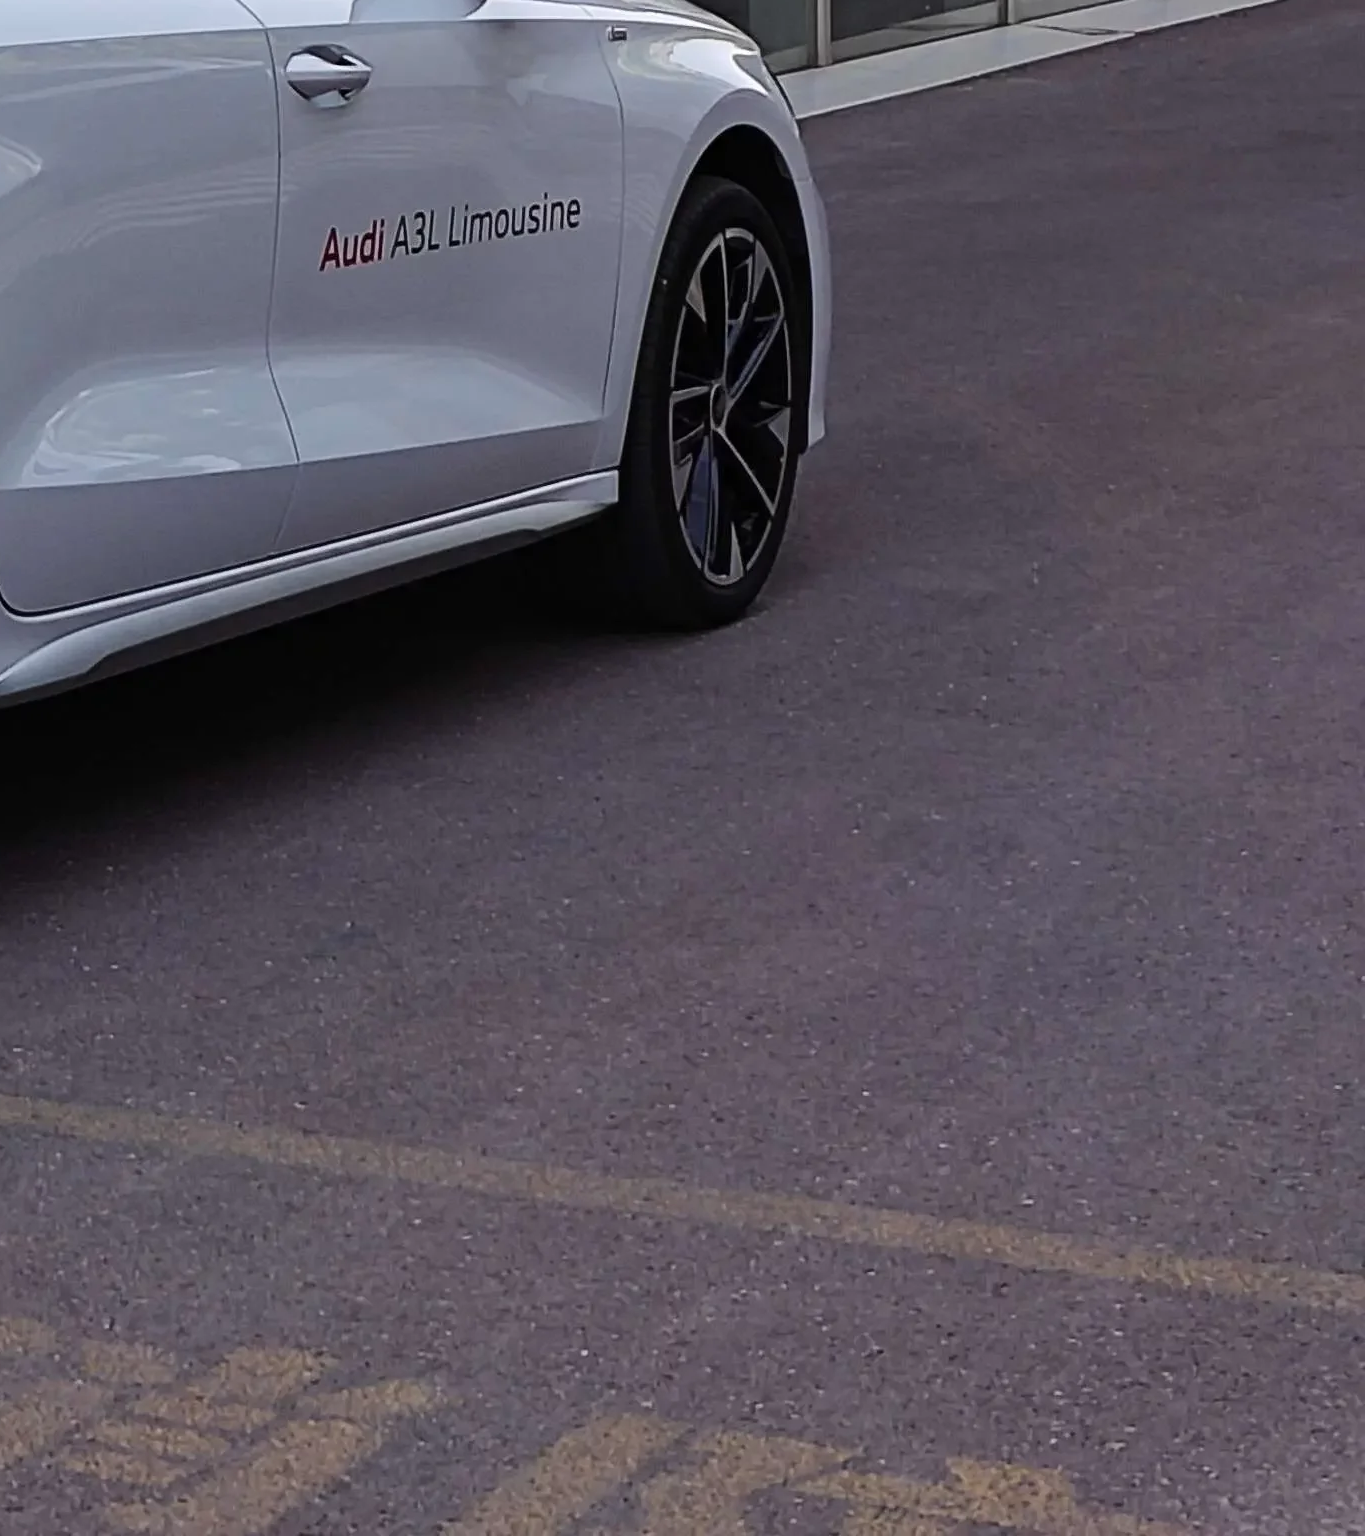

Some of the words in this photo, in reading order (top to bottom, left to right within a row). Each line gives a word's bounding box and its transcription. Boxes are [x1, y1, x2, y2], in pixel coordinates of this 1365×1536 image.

[318, 218, 386, 272] Audi
[389, 209, 441, 260] A3L
[447, 191, 582, 248] Limousine
